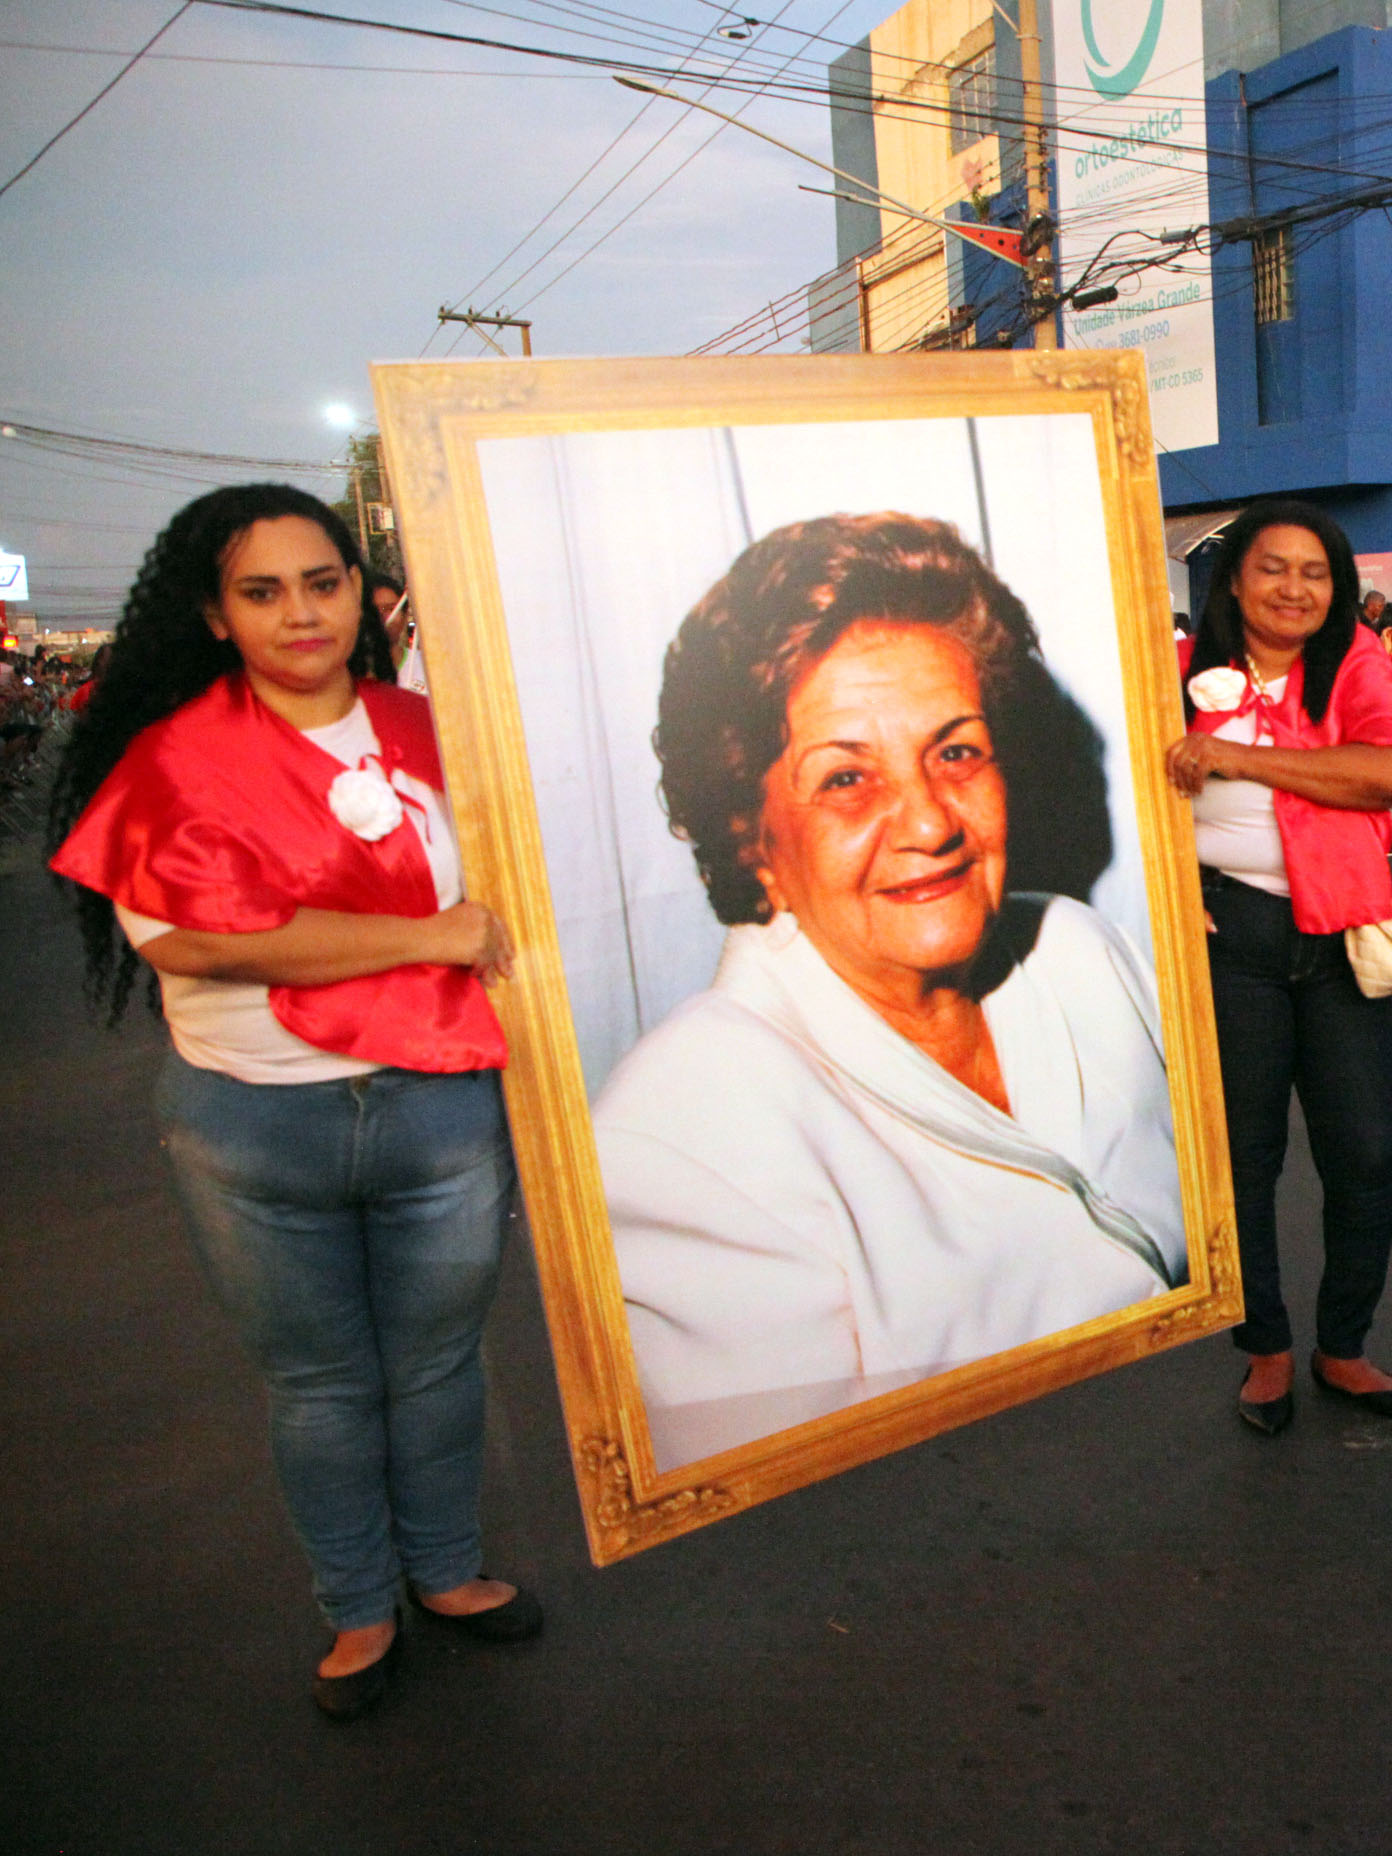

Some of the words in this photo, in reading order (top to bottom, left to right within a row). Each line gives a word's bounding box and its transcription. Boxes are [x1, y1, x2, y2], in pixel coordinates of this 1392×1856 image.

[1074, 307, 1115, 336] Unidade
[1158, 281, 1200, 309] Grande
[1120, 320, 1169, 348] 3681-0990
